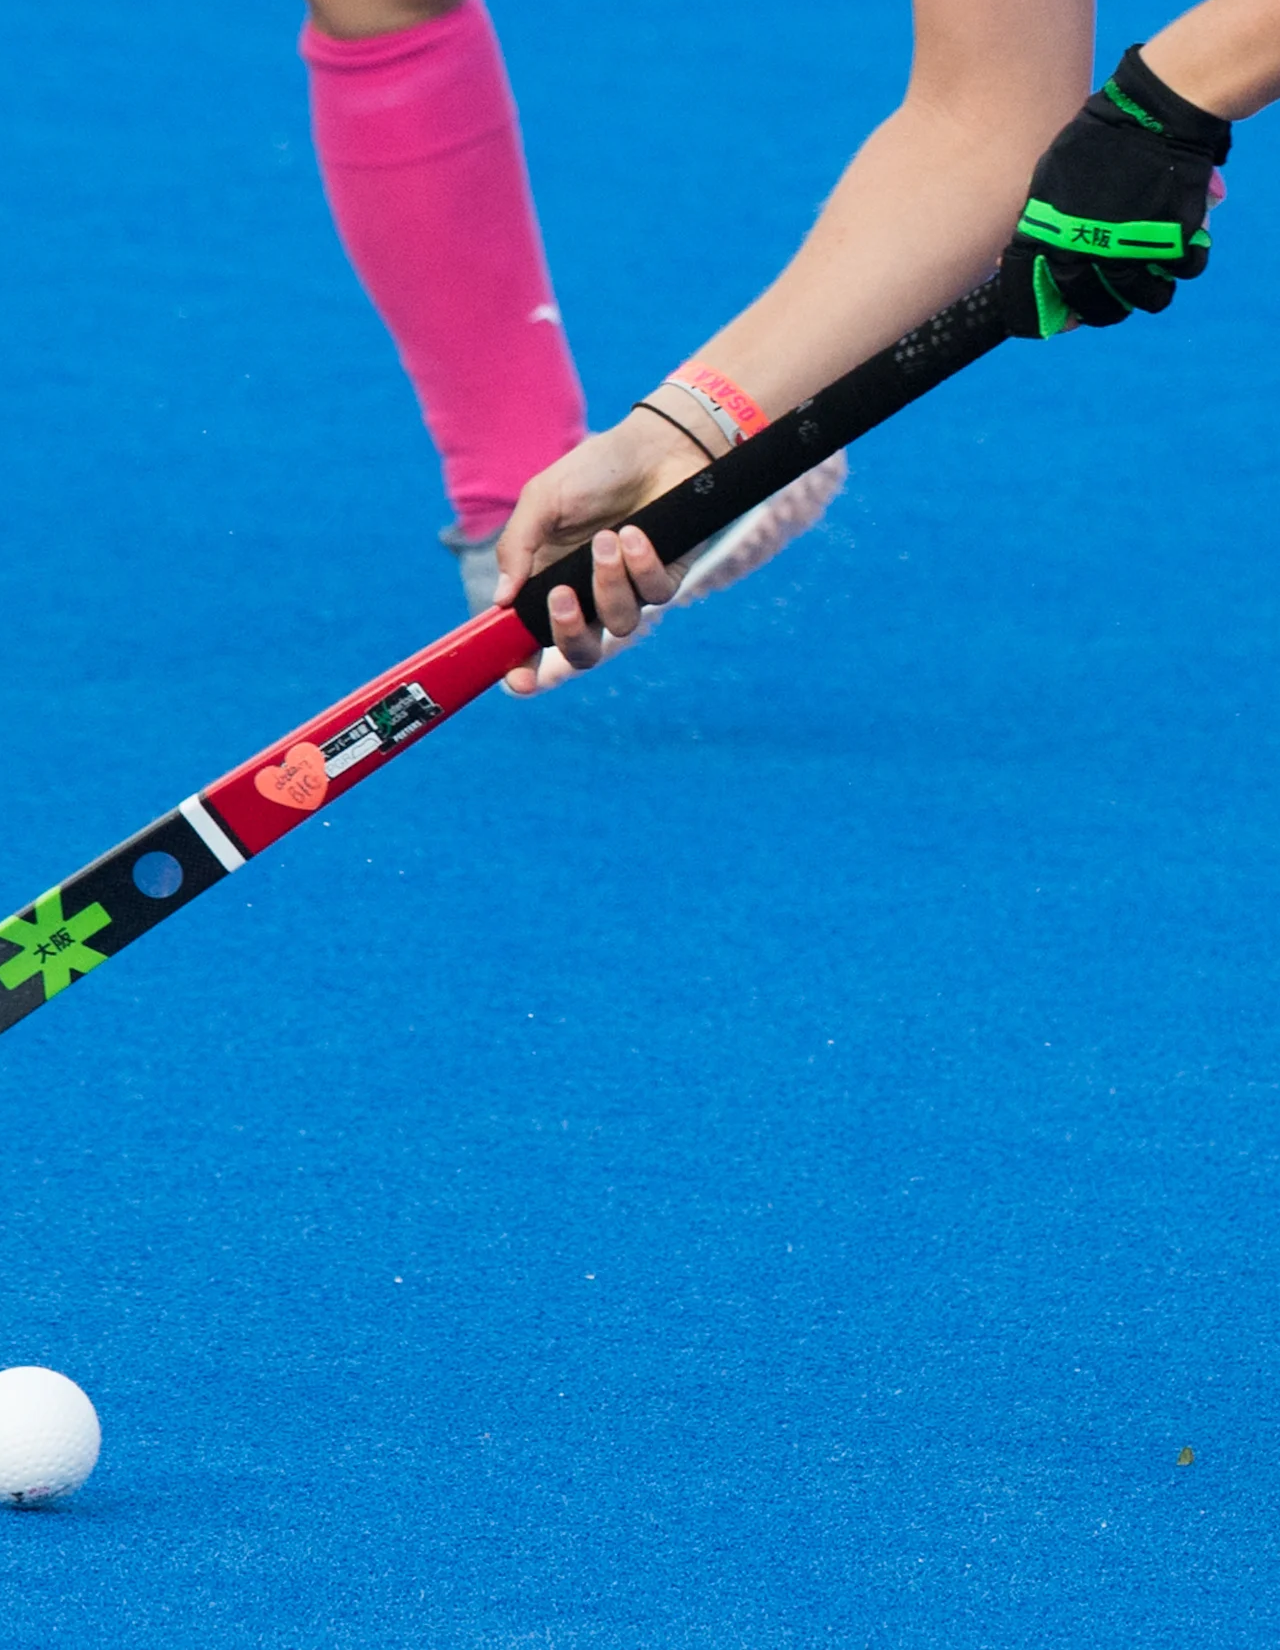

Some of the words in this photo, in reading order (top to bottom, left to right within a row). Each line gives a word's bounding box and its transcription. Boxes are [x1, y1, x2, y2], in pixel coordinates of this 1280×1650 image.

[1070, 224, 1113, 250] 大阪
[694, 369, 757, 422] OSAKA
[32, 926, 76, 964] 大阪
